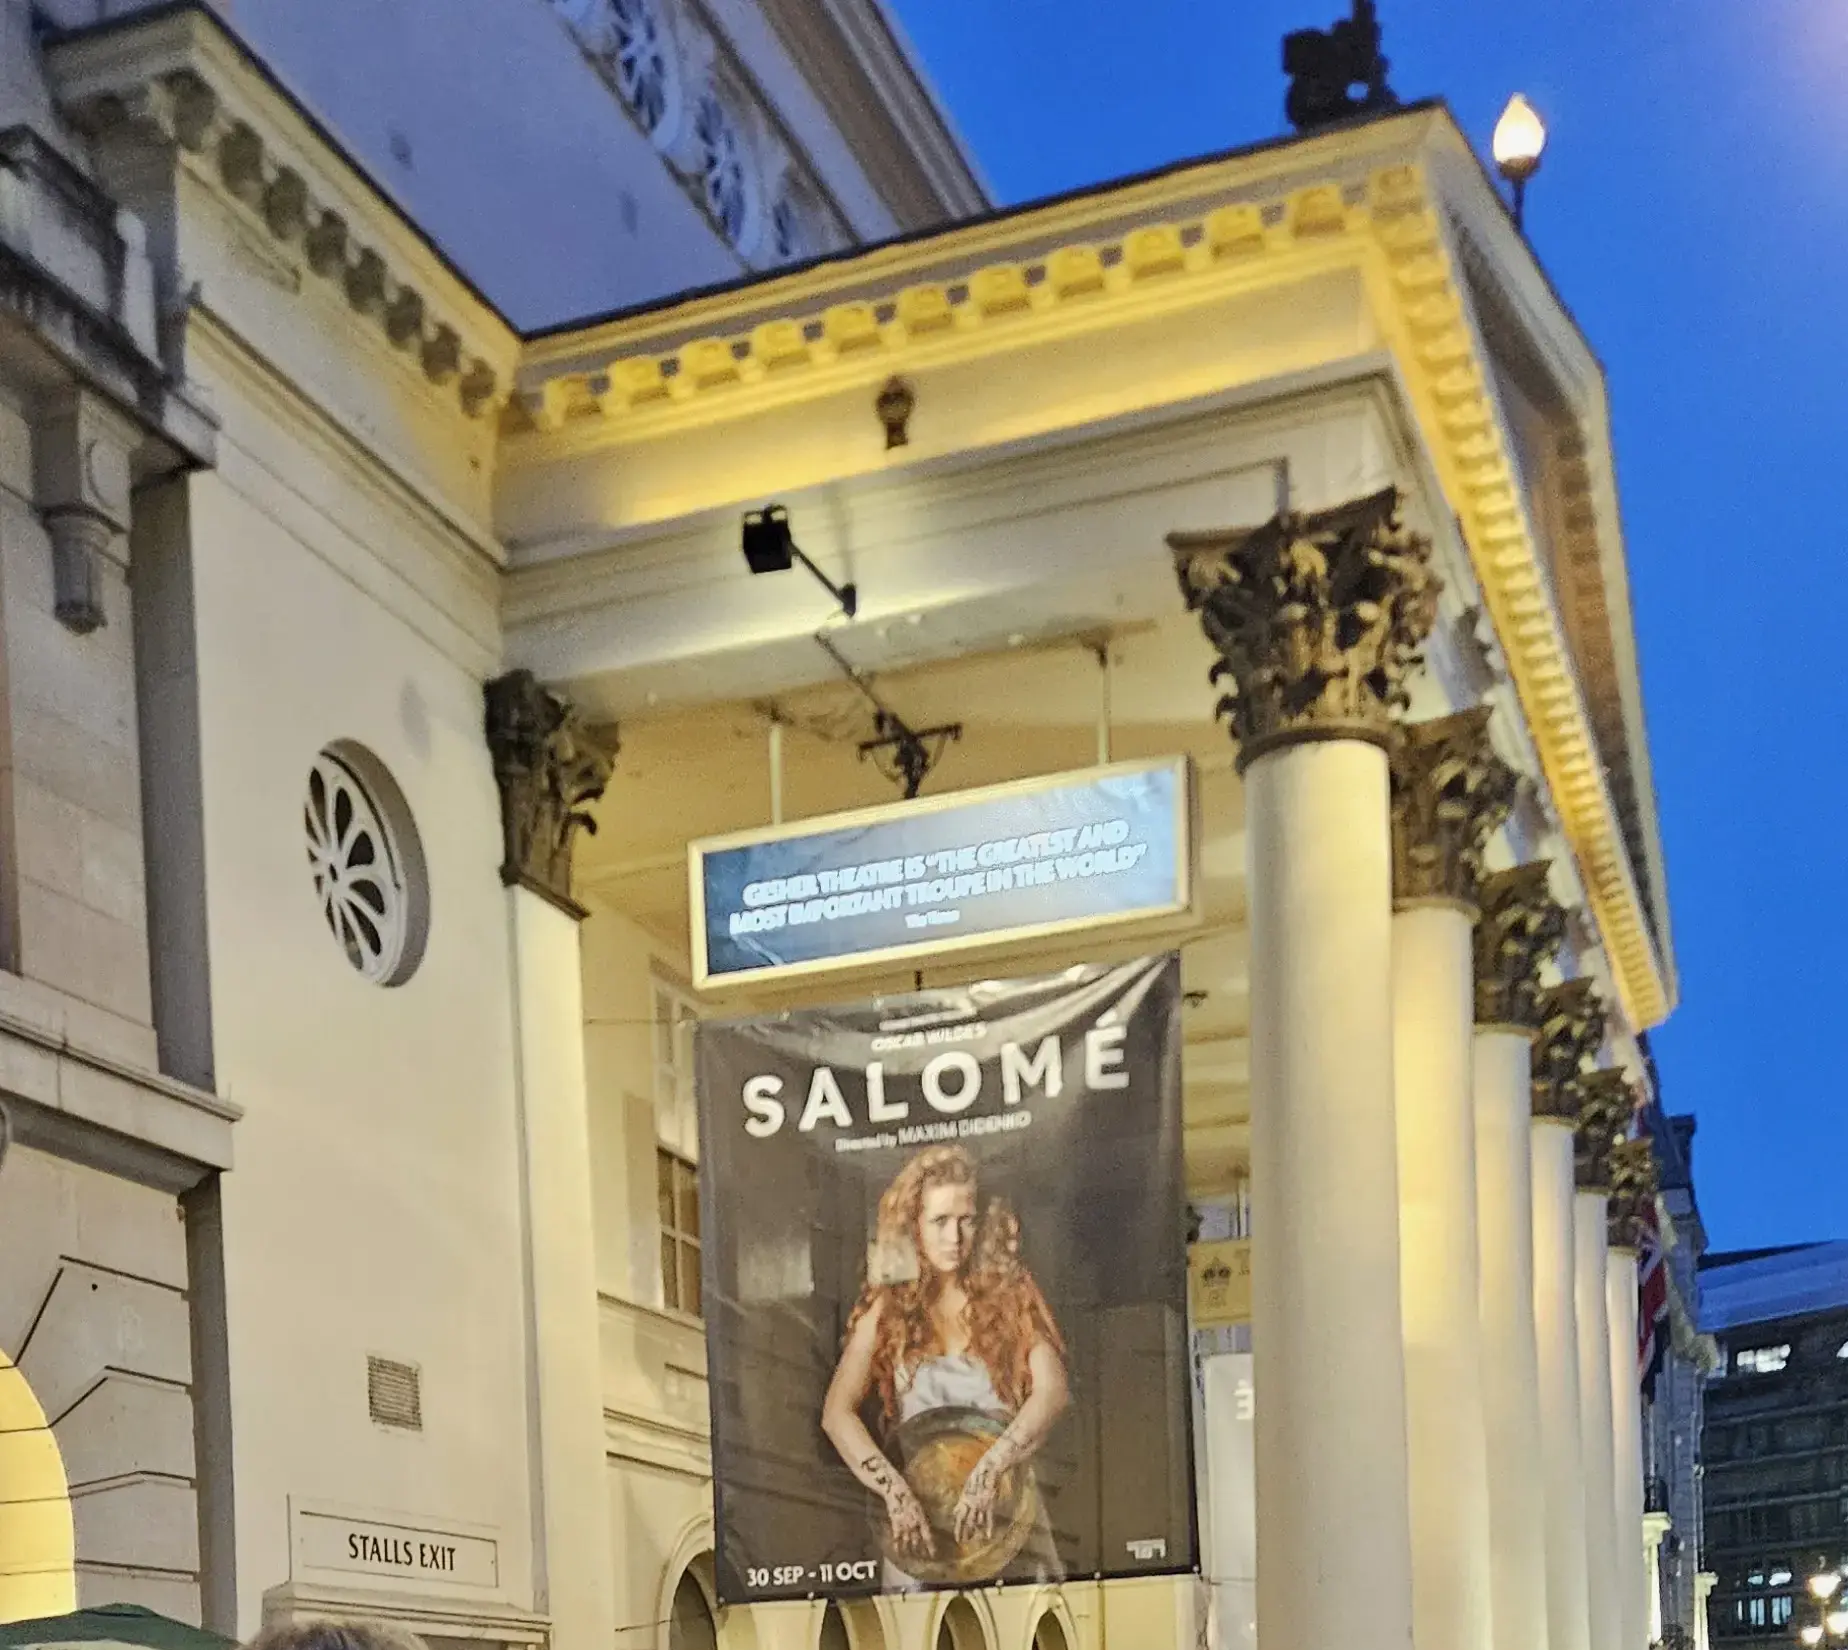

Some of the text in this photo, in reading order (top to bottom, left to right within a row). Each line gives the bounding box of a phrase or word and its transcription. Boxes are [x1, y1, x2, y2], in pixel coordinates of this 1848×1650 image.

[743, 874, 820, 907] GESHER
[817, 859, 904, 893] THEATRE
[904, 855, 926, 880] IS
[977, 829, 1078, 867] GREATEST
[1077, 819, 1129, 849] AND
[729, 905, 787, 935] MOST
[788, 886, 904, 926] IMPORTANT
[906, 872, 987, 906] TROUPE
[986, 867, 1013, 895] IN
[1013, 859, 1057, 888] THE
[871, 1032, 925, 1052] OSCAR
[742, 1009, 1130, 1138] SALOMÉ
[834, 1134, 882, 1152] Directed
[899, 1120, 957, 1145] MAXIM
[957, 1110, 1032, 1138] DIDENKO
[348, 1533, 456, 1571] STALLS EXIT
[747, 1568, 769, 1587] 30
[773, 1566, 803, 1585] SEP
[820, 1564, 833, 1582] 11
[836, 1561, 877, 1580] OCT
